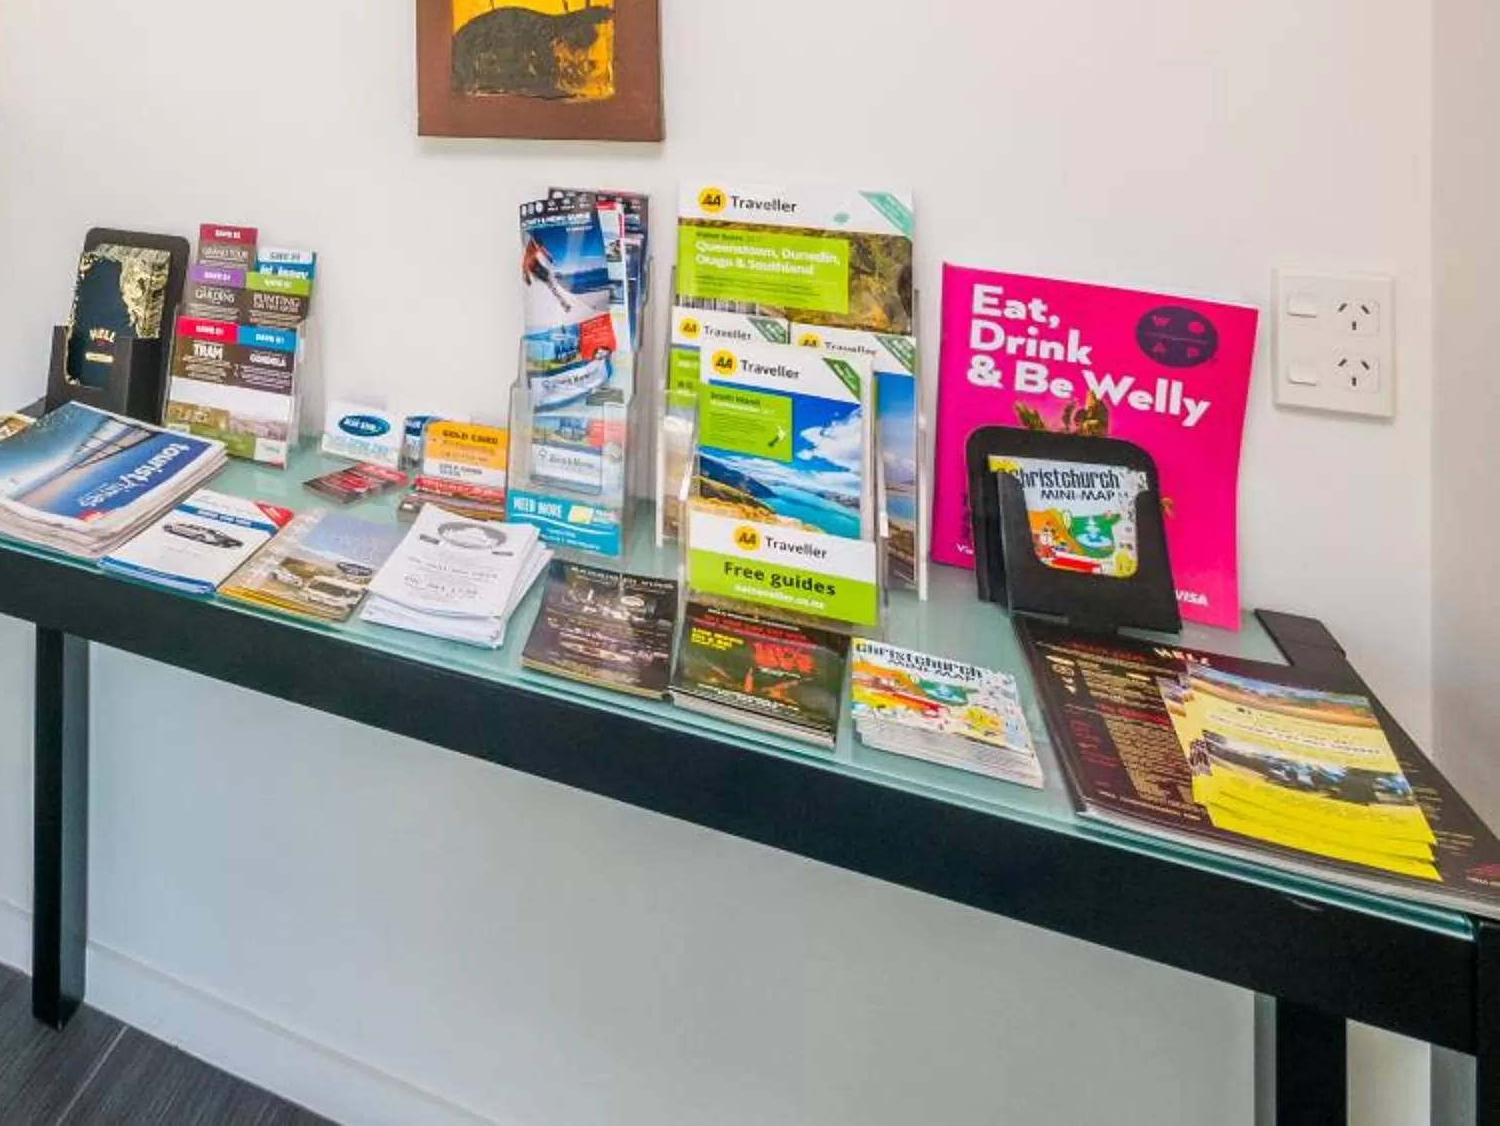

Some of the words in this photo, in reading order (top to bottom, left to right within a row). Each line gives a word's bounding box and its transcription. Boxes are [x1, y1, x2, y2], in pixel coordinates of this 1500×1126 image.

[701, 191, 721, 206] AA
[731, 195, 798, 213] Traveller
[695, 240, 778, 258] Queenstown,
[781, 247, 840, 266] Dunedin,
[695, 253, 733, 270] Otago
[746, 258, 814, 275] Southland
[253, 292, 300, 307] PUNTING
[972, 283, 1061, 329] Eat,
[704, 325, 751, 341] Traveller
[969, 318, 1092, 366] Drink
[193, 343, 224, 358] TRAM
[716, 356, 733, 369] AA
[740, 359, 800, 380] Traveller
[967, 354, 1003, 389] &
[1014, 360, 1074, 398] Be
[1083, 368, 1211, 427] Welly
[537, 500, 562, 518] MORE
[739, 532, 757, 545] AA
[765, 536, 827, 559] Traveller
[724, 561, 765, 581] Free
[771, 573, 836, 596] guides
[1174, 589, 1209, 607] VISA
